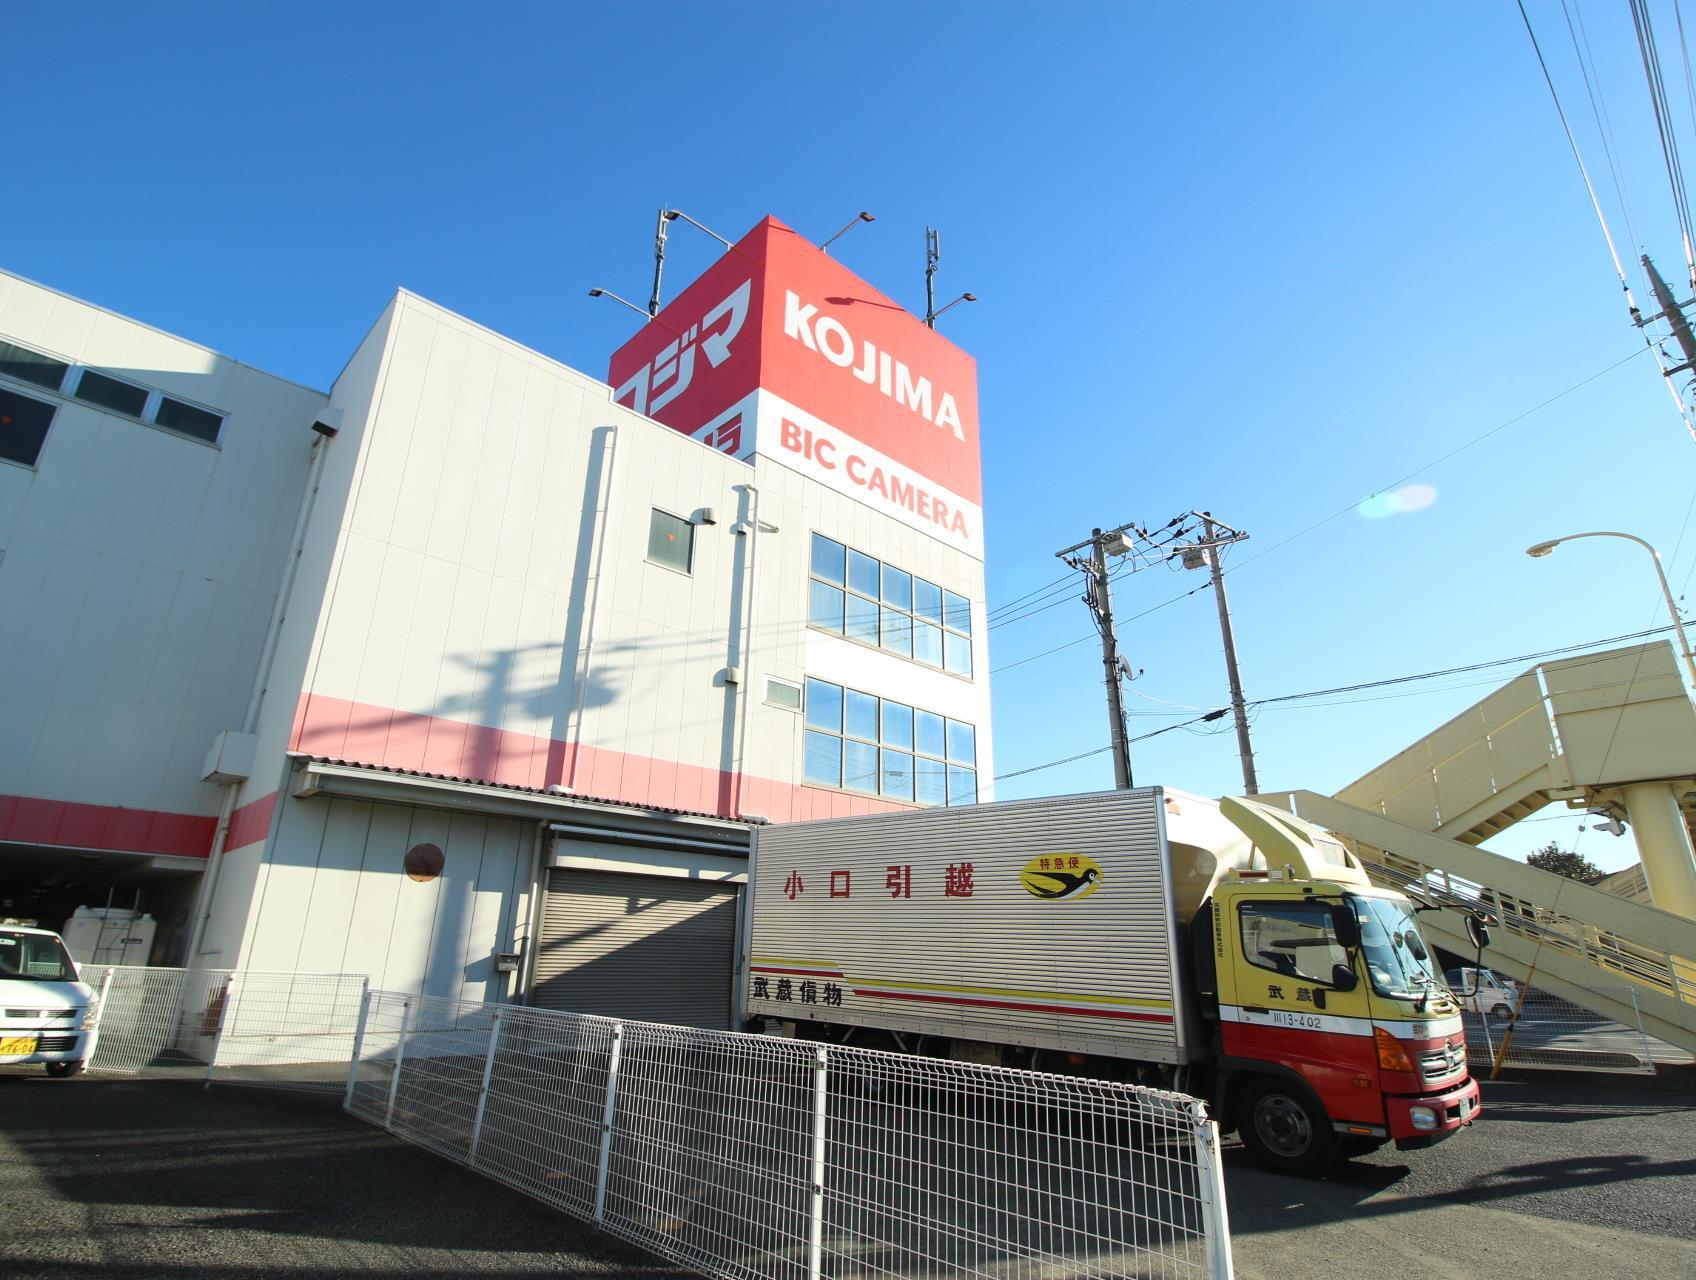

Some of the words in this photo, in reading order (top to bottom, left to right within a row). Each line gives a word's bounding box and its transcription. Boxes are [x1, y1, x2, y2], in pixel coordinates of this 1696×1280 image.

[784, 288, 966, 442] KOJIMA
[780, 417, 836, 470] BIC
[846, 455, 969, 540] CAMERA
[783, 862, 974, 900] 小口引越
[1040, 857, 1079, 870] 特急便
[1268, 985, 1312, 1002] 武蔵
